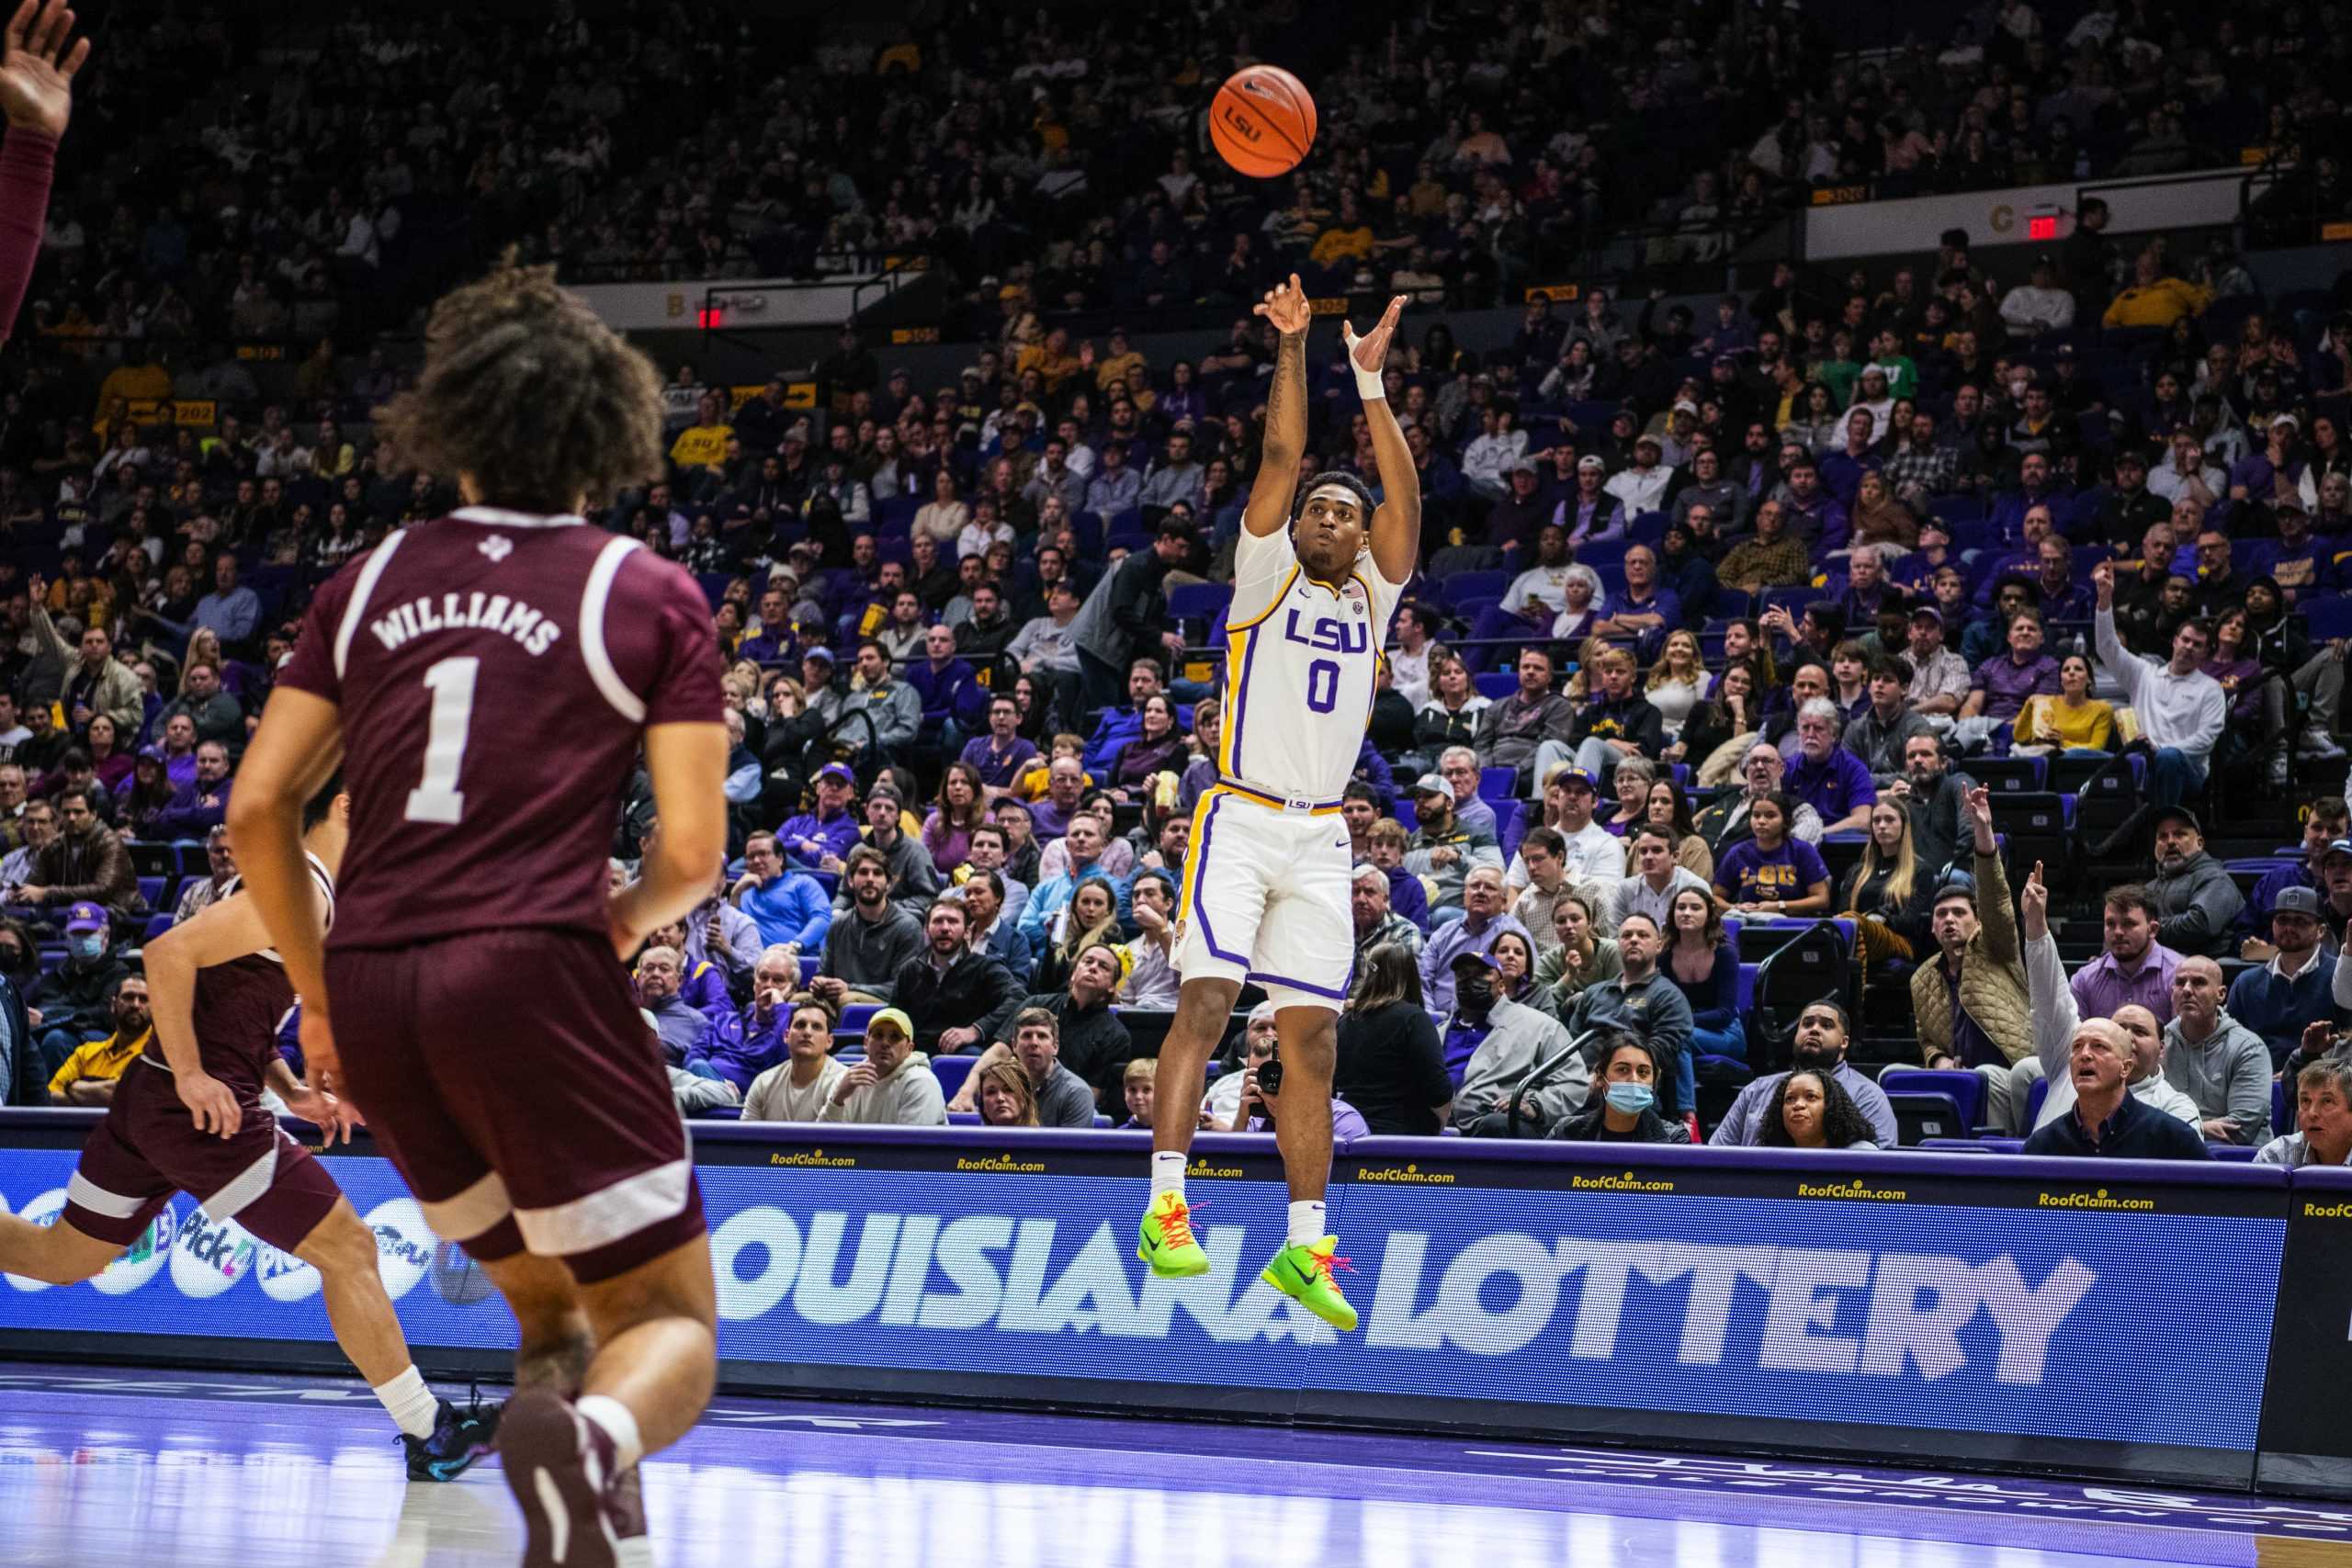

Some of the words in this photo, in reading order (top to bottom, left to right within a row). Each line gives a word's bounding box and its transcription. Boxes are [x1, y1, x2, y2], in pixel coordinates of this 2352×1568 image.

[1224, 106, 1262, 142] LSU
[1990, 205, 2014, 233] C
[370, 592, 561, 656] WILLIAMS
[1284, 608, 1367, 654] LSU
[1307, 659, 1340, 714] 0
[404, 656, 481, 824] 1
[1289, 800, 1310, 809] LSU
[771, 1149, 855, 1167] RoofClaim.com
[957, 1154, 1045, 1172] RoofClaim.com
[1358, 1164, 1455, 1183] RoofClaim.com
[1572, 1171, 1674, 1191] RoofClaim.com
[1798, 1179, 1905, 1200] RoofClaim.com
[2039, 1189, 2154, 1210] RoofClaim.com
[711, 1206, 1339, 1344] OUISIANA
[1365, 1232, 2098, 1385] LOTTERY
[1810, 1486, 2170, 1517] BROWN
